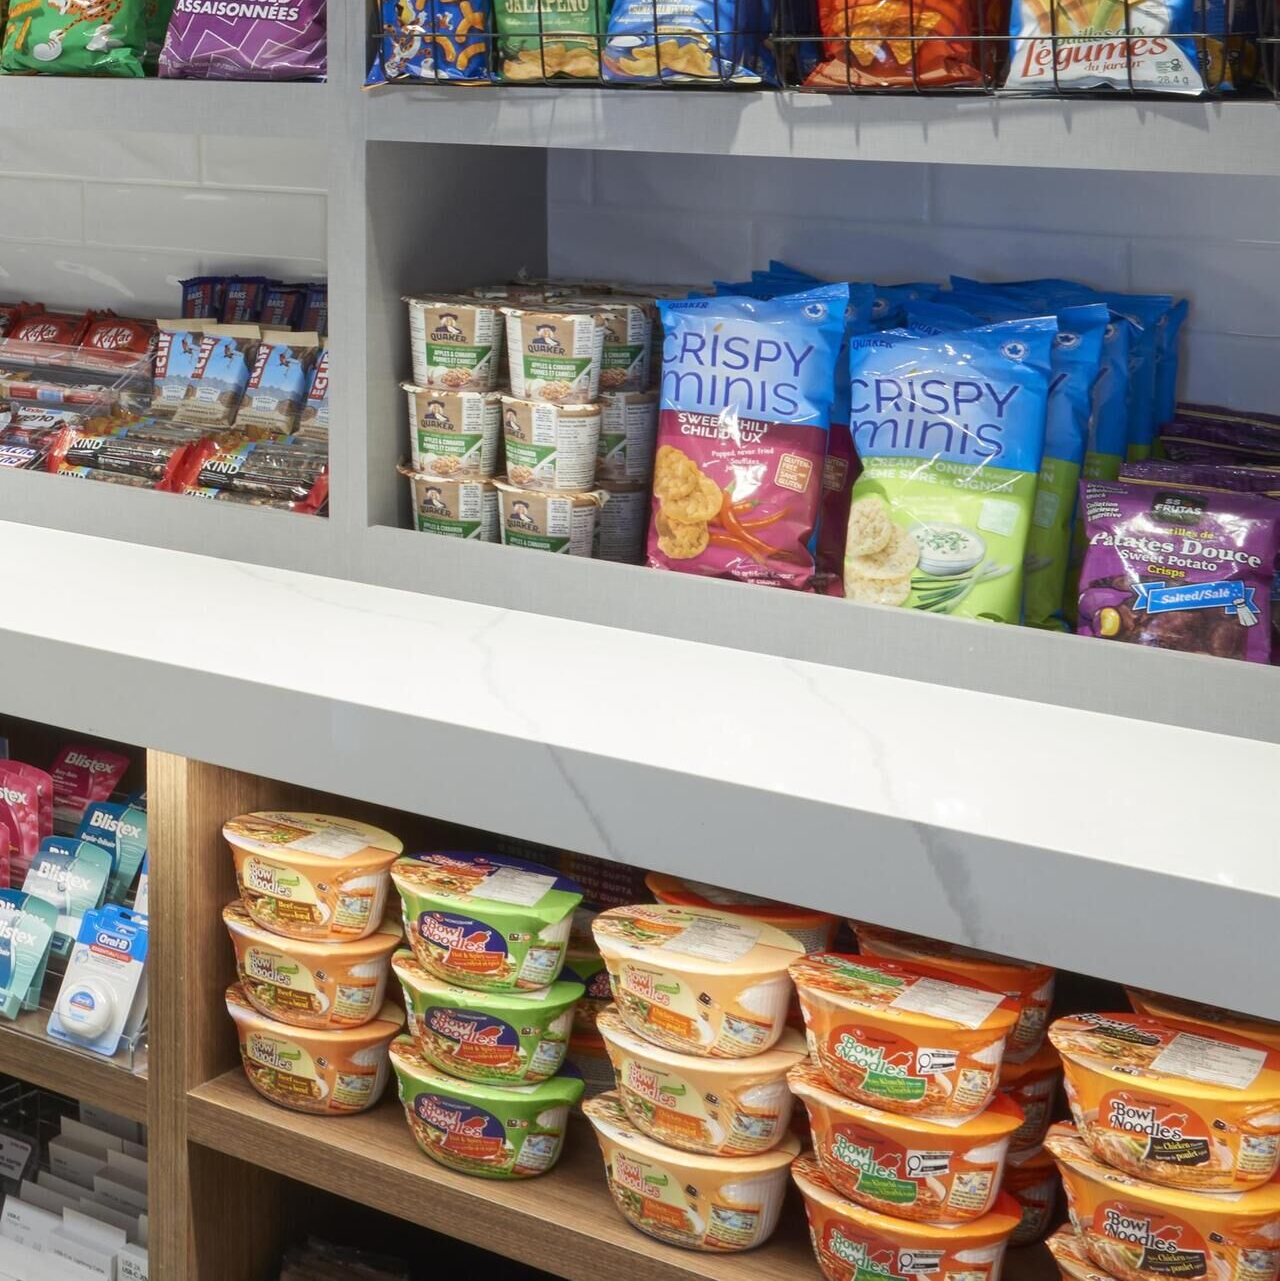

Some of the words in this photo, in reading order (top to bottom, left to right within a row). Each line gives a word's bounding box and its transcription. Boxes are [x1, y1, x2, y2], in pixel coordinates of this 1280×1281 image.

[1021, 37, 1168, 78] Légumes
[156, 332, 171, 368] CLIF
[431, 333, 467, 343] QUAKER
[528, 345, 566, 356] QUAKER
[198, 338, 216, 369] CLIF
[254, 345, 270, 378] CLIF
[663, 326, 815, 377] CRISPY
[851, 379, 1019, 417] CRISPY
[421, 420, 454, 431] QUAKER
[681, 424, 717, 437] CHILI
[71, 438, 103, 450] KIND
[853, 419, 1002, 458] minis
[204, 460, 239, 475] KIND
[870, 458, 917, 468] CREAM
[936, 462, 984, 475] ONION
[953, 479, 1013, 493] OIGNON
[420, 505, 453, 517] QUAKER
[1154, 503, 1202, 515] FRUTAS
[506, 520, 540, 533] QUAKER
[1200, 531, 1214, 539] de
[1090, 531, 1174, 555] Patates
[1180, 538, 1262, 569] Douce
[1121, 549, 1165, 565] Sweet
[1168, 556, 1217, 571] Potato
[1147, 564, 1185, 579] Crisps
[1161, 588, 1230, 604] Salted/Salé
[65, 752, 115, 774] Blistex
[90, 811, 142, 838] Blistex
[39, 861, 91, 890] Blistex
[423, 925, 486, 951] Noodles
[424, 916, 463, 938] Bowl
[99, 934, 130, 950] Oral-B
[433, 1020, 497, 1046] Noodles
[434, 1011, 476, 1034] Bowl
[836, 1046, 907, 1078] Noodles
[840, 1036, 884, 1063] Bowl
[420, 1098, 463, 1120] Bowl
[420, 1107, 483, 1136] Noodles
[1112, 1101, 1157, 1126] Bowl
[1110, 1114, 1183, 1142] Noodles
[837, 1135, 874, 1164] Bowl
[1163, 1140, 1190, 1151] Chicken
[1176, 1149, 1198, 1161] poulet
[832, 1146, 897, 1180] Noodles
[1107, 1210, 1151, 1236] Bowl
[832, 1229, 868, 1256] Bowl
[1104, 1223, 1177, 1253] Noodles
[829, 1240, 890, 1275] Noodles
